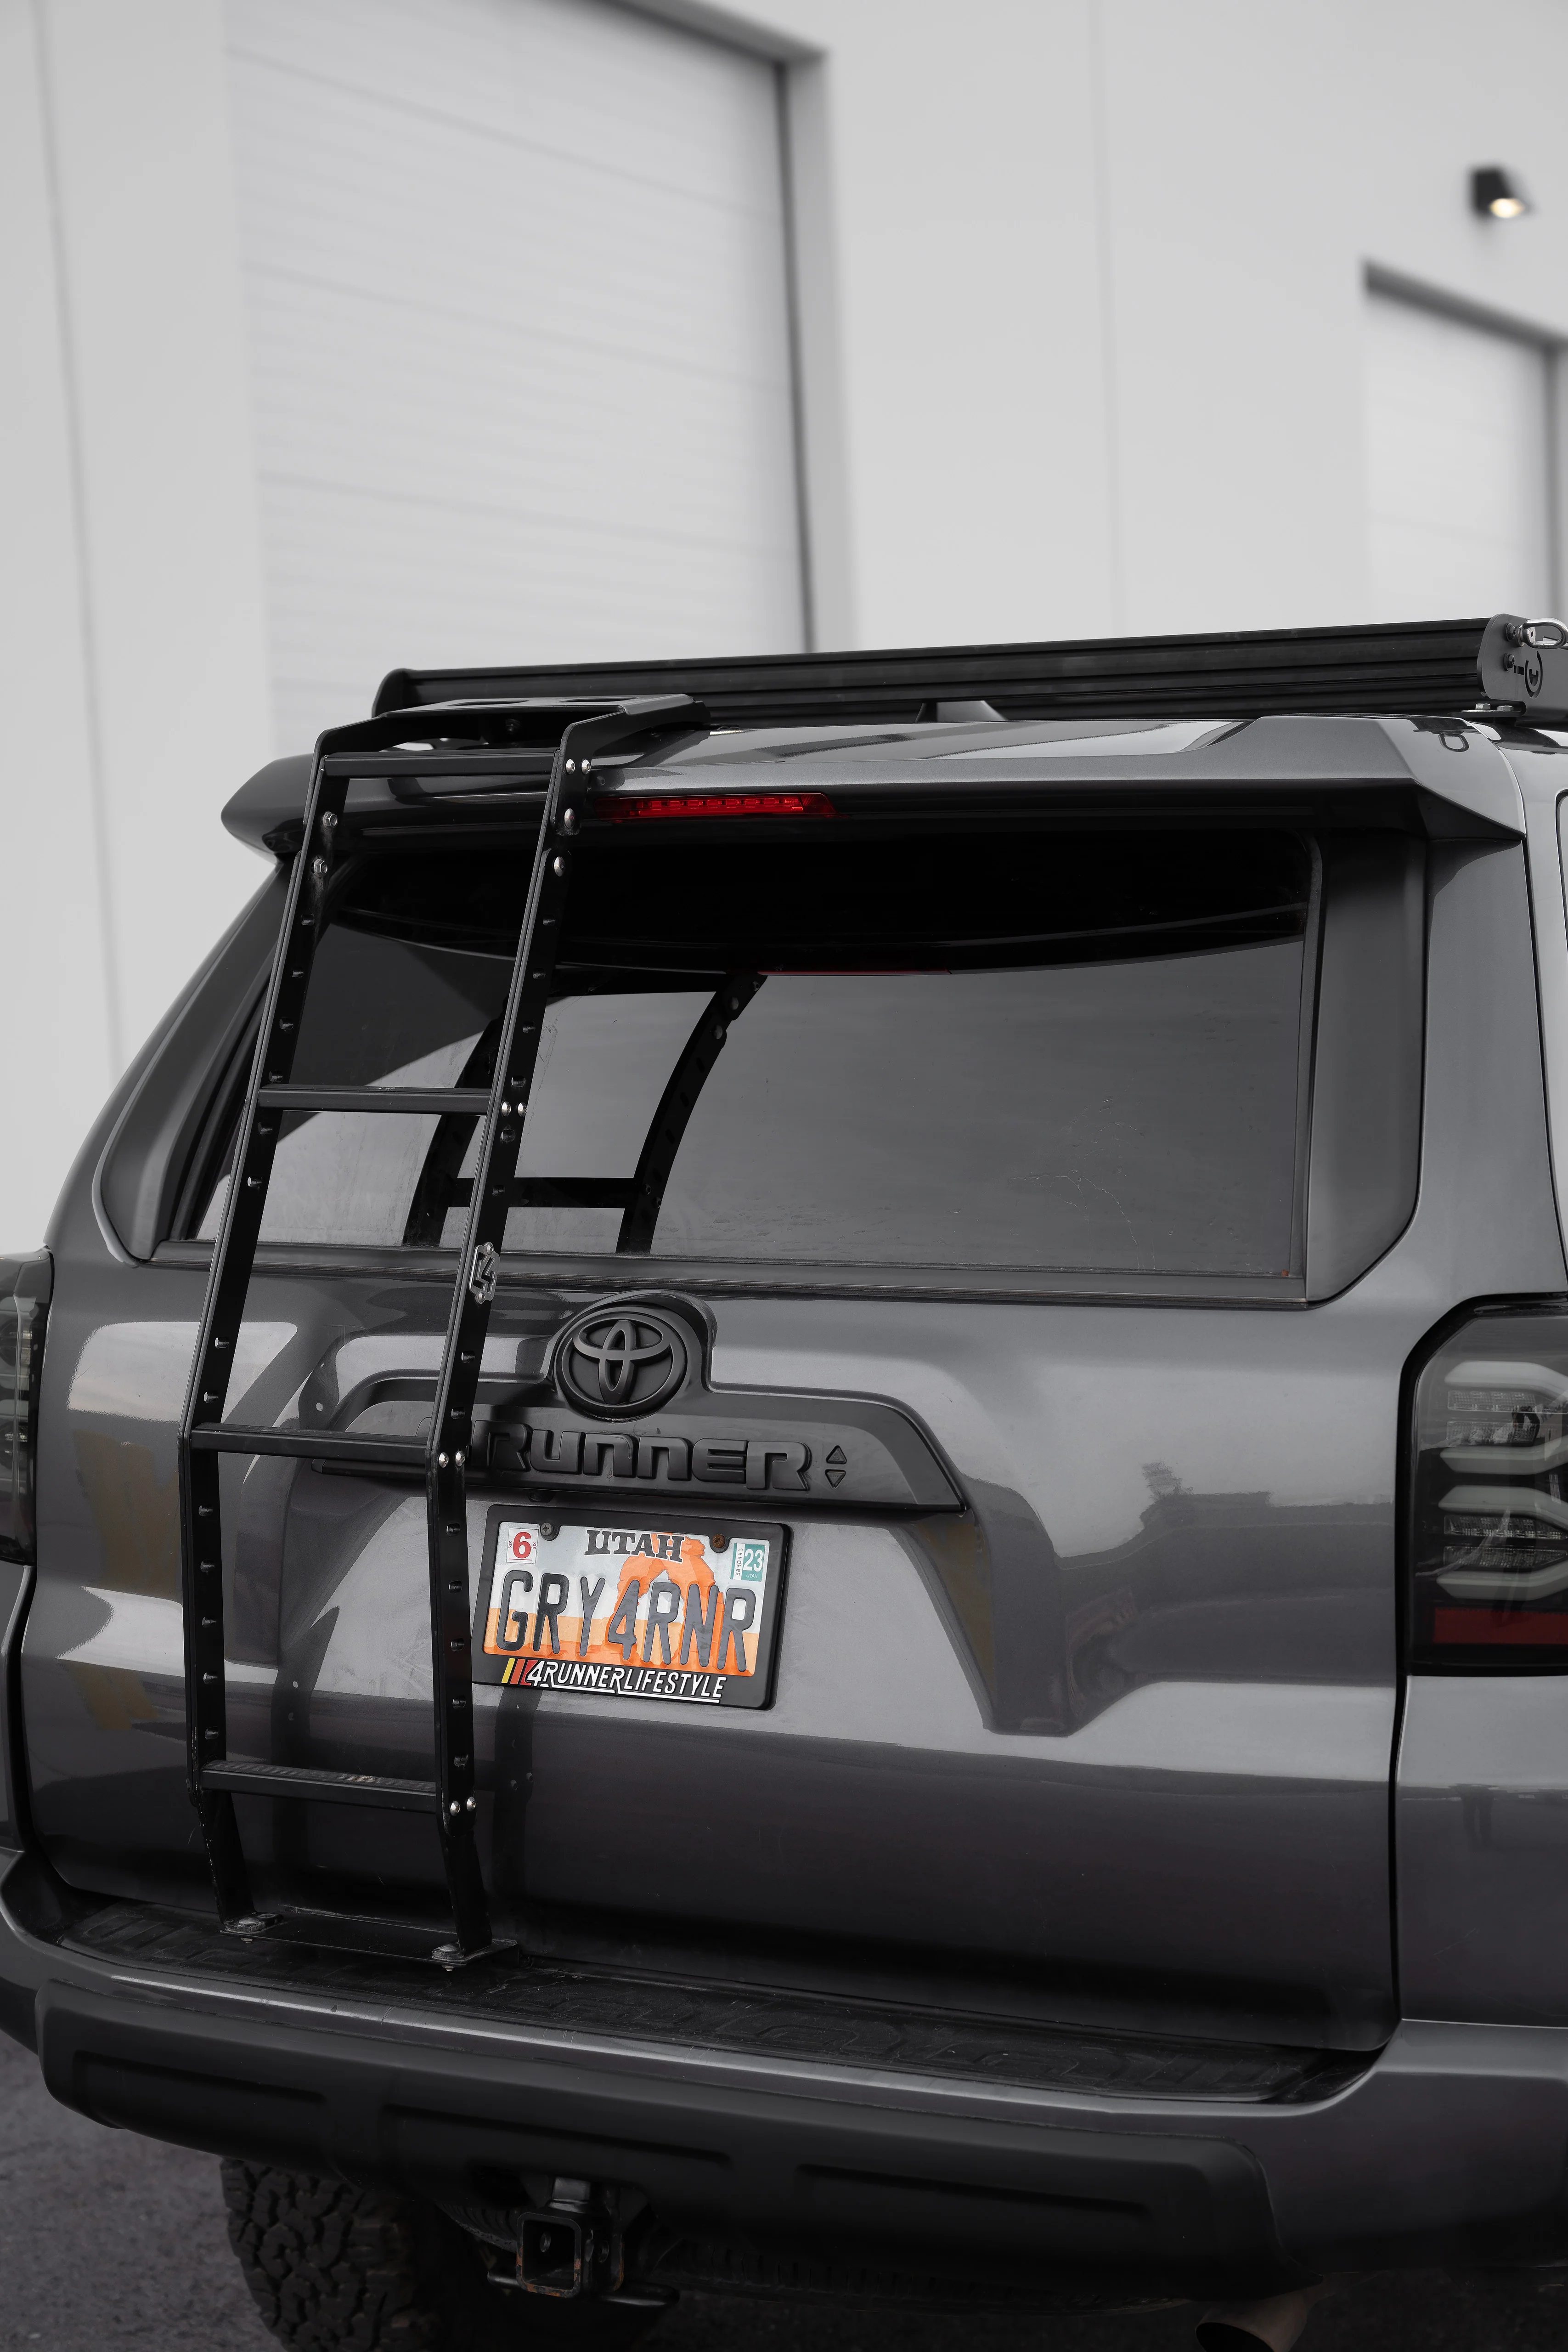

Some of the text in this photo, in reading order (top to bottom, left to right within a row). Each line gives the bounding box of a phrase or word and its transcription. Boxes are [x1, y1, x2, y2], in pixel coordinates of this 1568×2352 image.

[465, 1419, 812, 1491] RUNNER
[513, 1532, 532, 1559] 6
[584, 1530, 685, 1562] UTAH
[743, 1549, 763, 1572] 23
[496, 1570, 756, 1672] GRY4RNR
[526, 1660, 726, 1702] 4RUNNERLIFESTYLE
